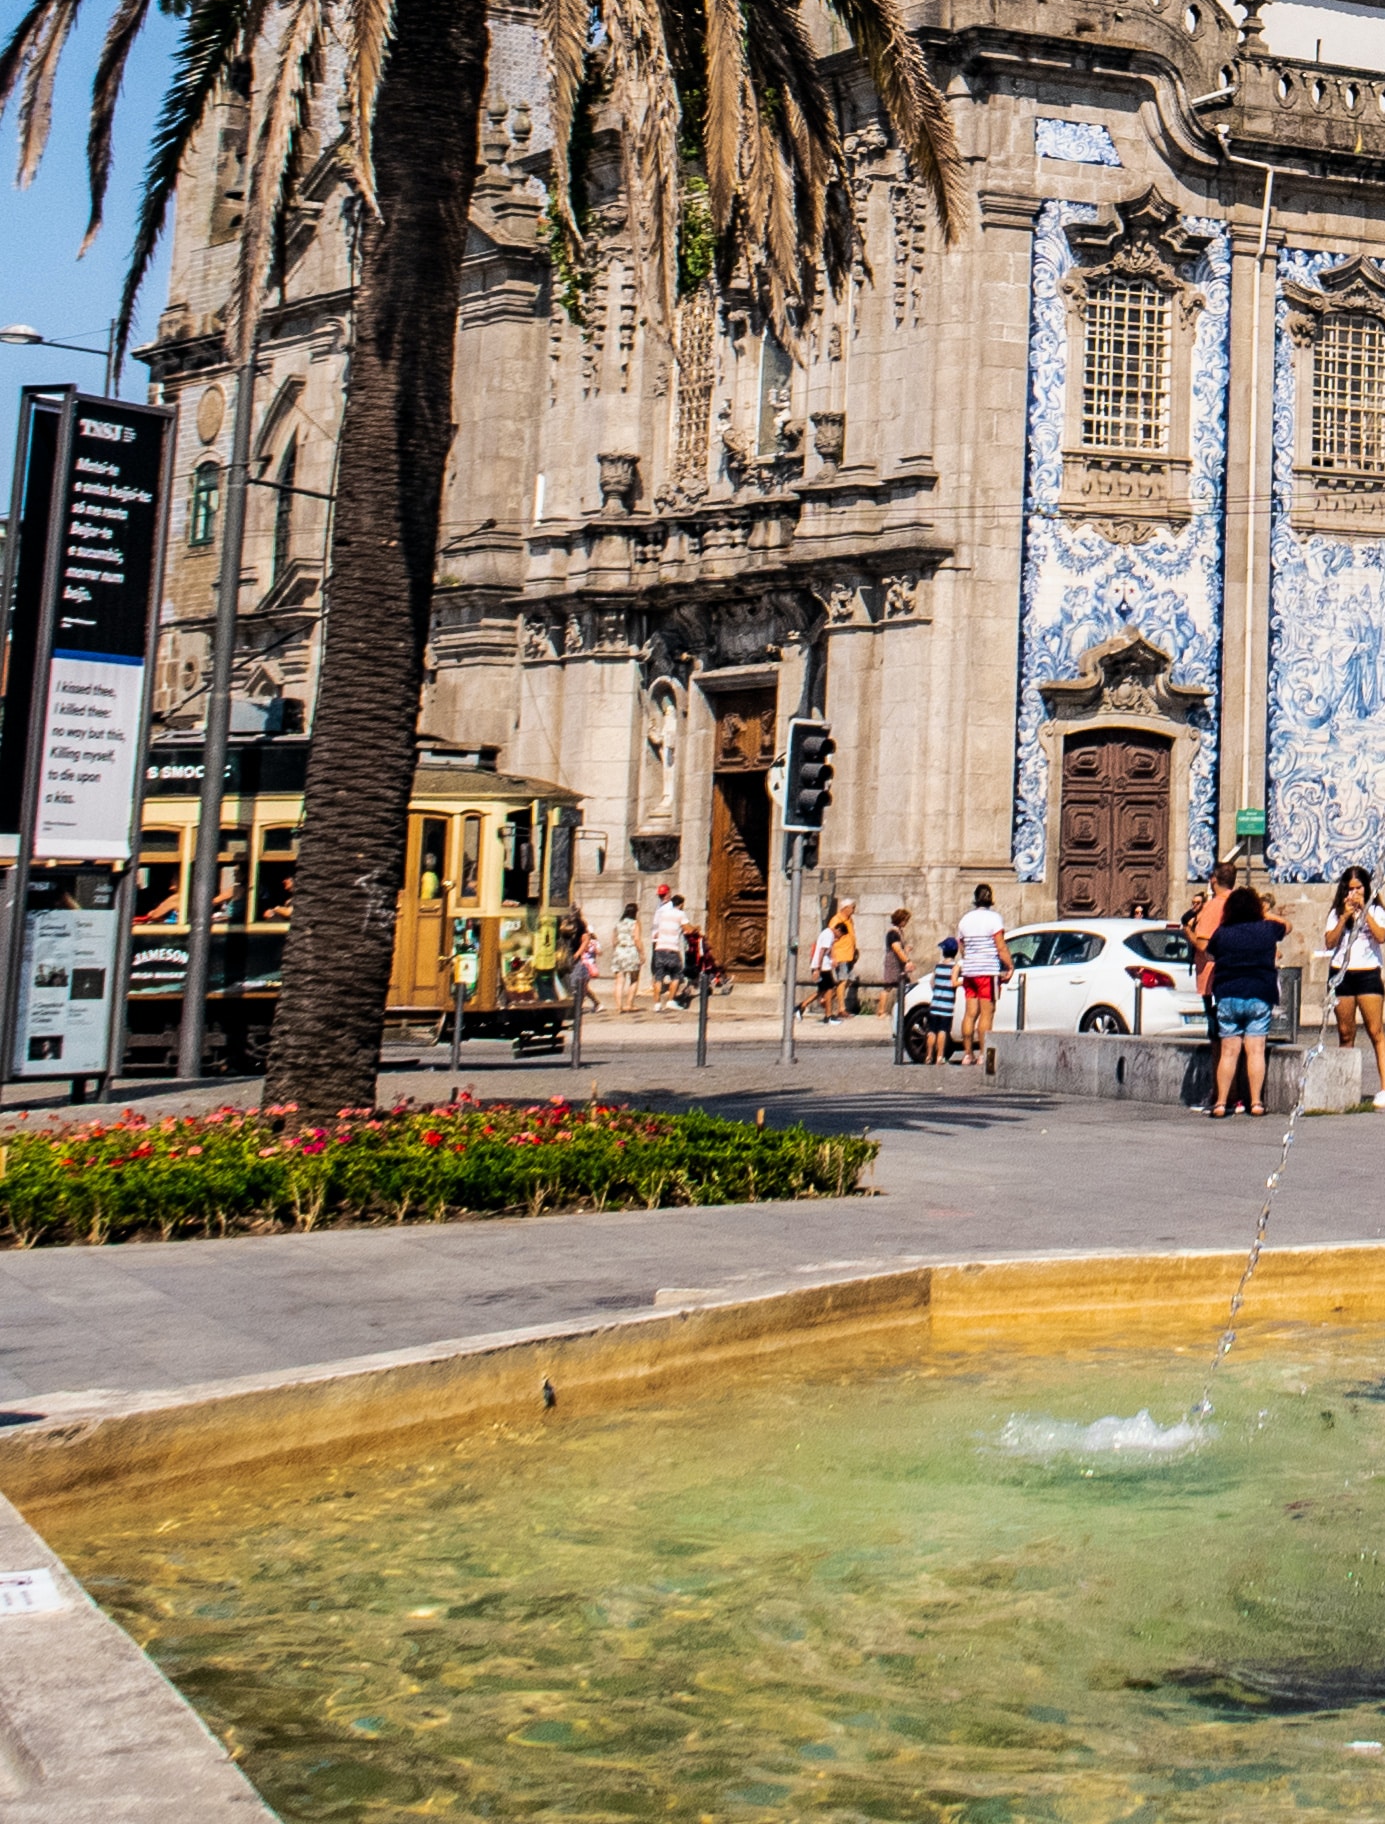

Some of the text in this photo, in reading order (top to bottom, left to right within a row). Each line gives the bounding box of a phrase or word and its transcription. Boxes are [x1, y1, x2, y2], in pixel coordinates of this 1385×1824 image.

[52, 726, 65, 738] no
[66, 727, 87, 741] way
[88, 727, 105, 740] but
[48, 768, 102, 785] to die upon
[132, 948, 191, 966] JAMESON
